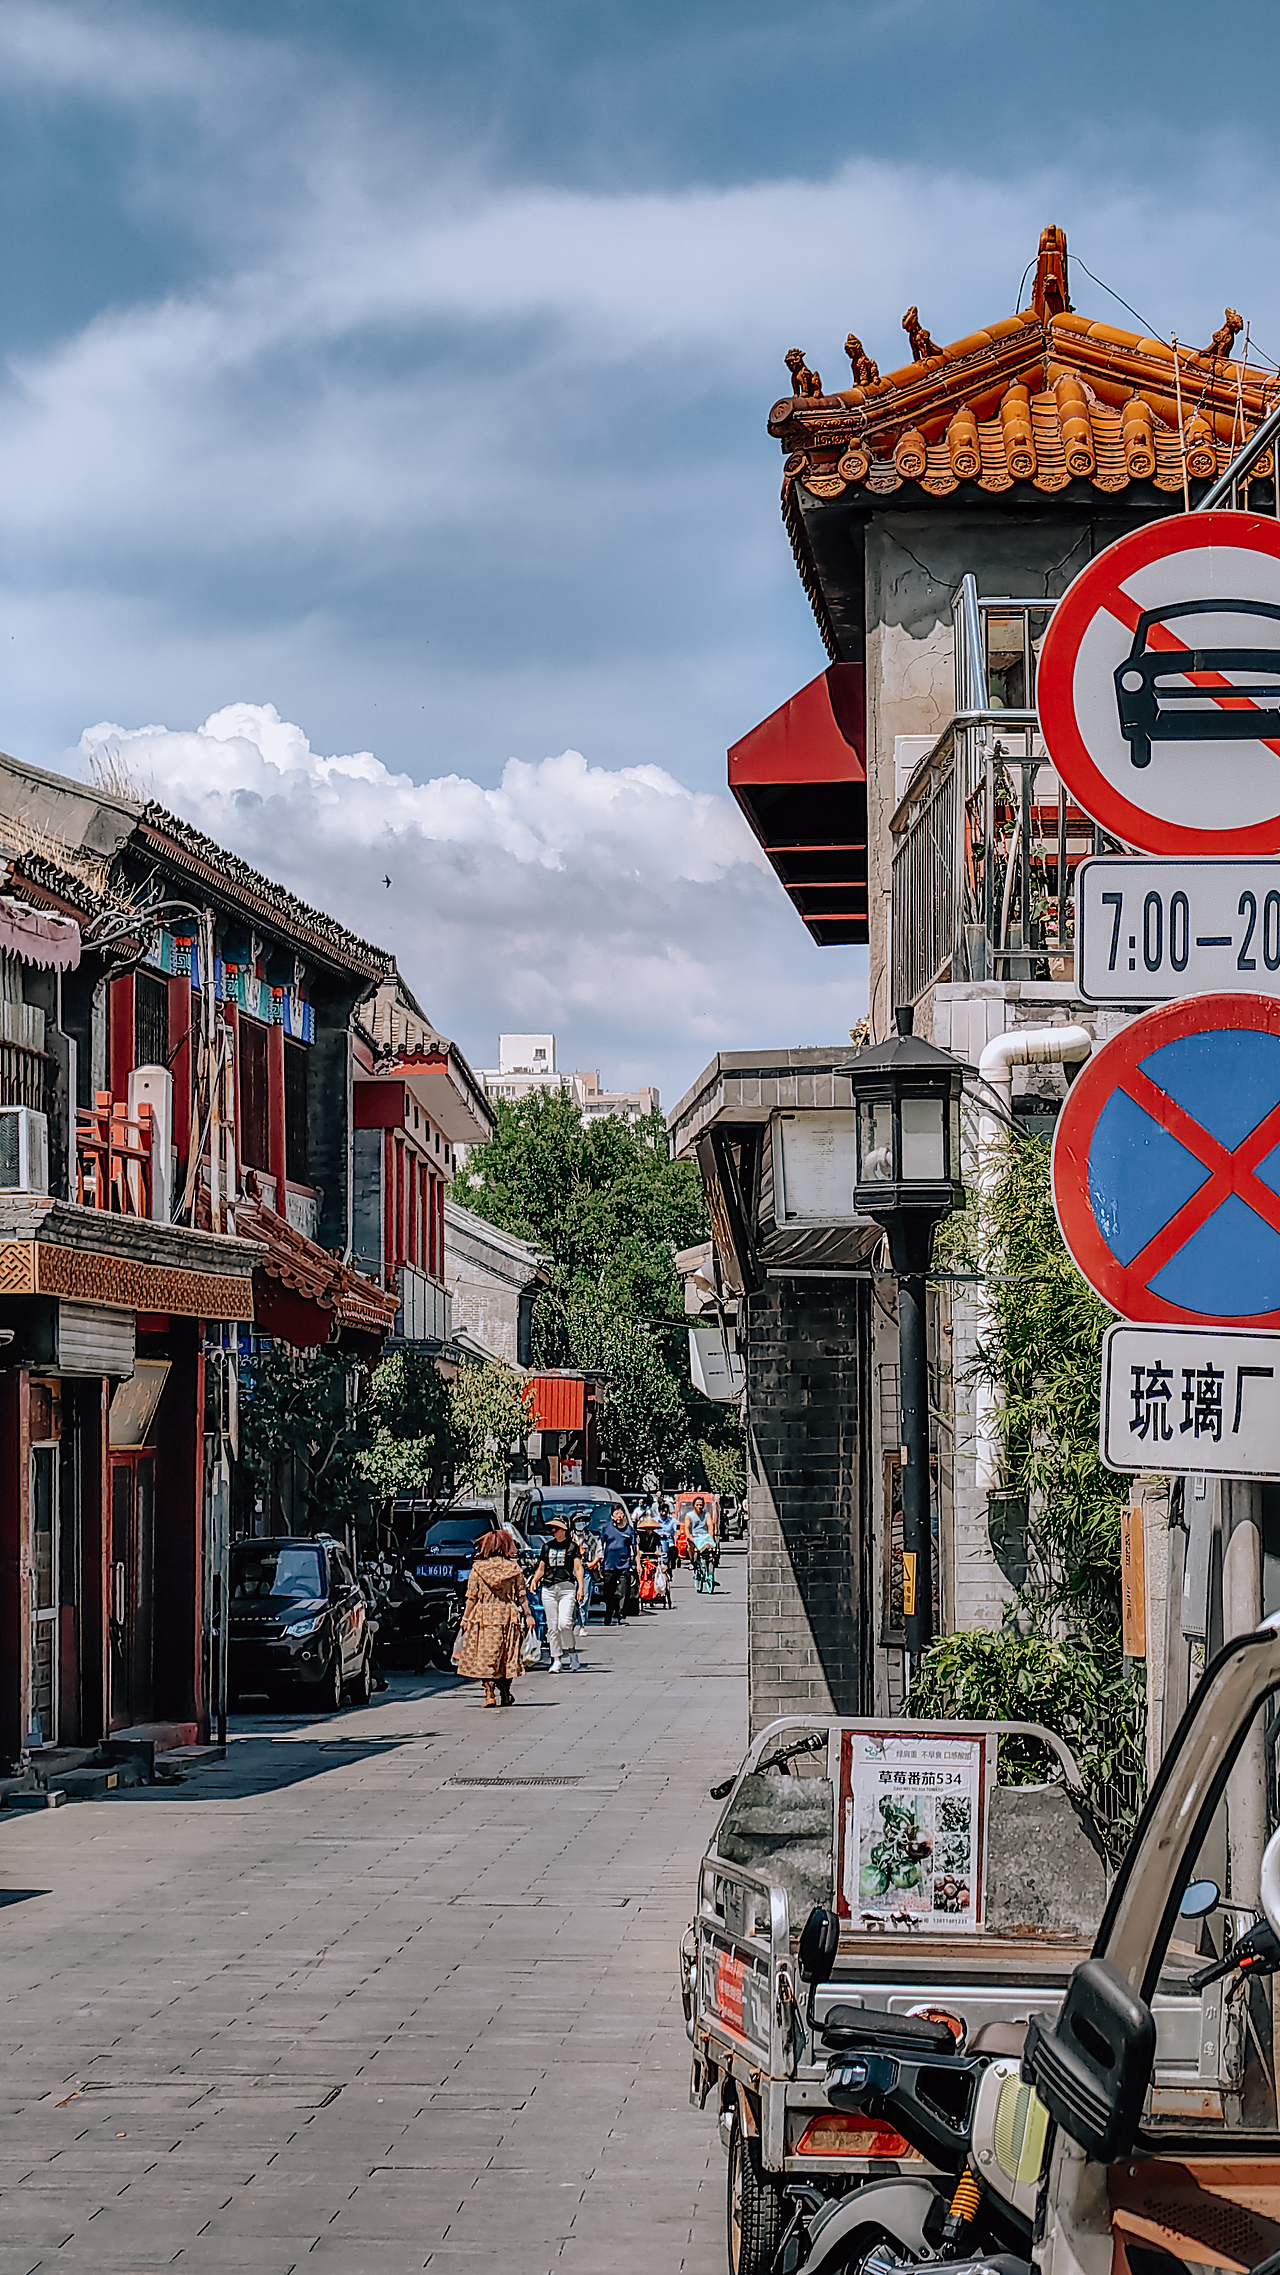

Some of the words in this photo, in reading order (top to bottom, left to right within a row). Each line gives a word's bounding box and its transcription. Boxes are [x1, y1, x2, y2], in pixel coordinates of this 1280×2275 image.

[1129, 1360, 1274, 1443] 琉璃厂
[879, 1770, 962, 1785] 草莓番茄534
